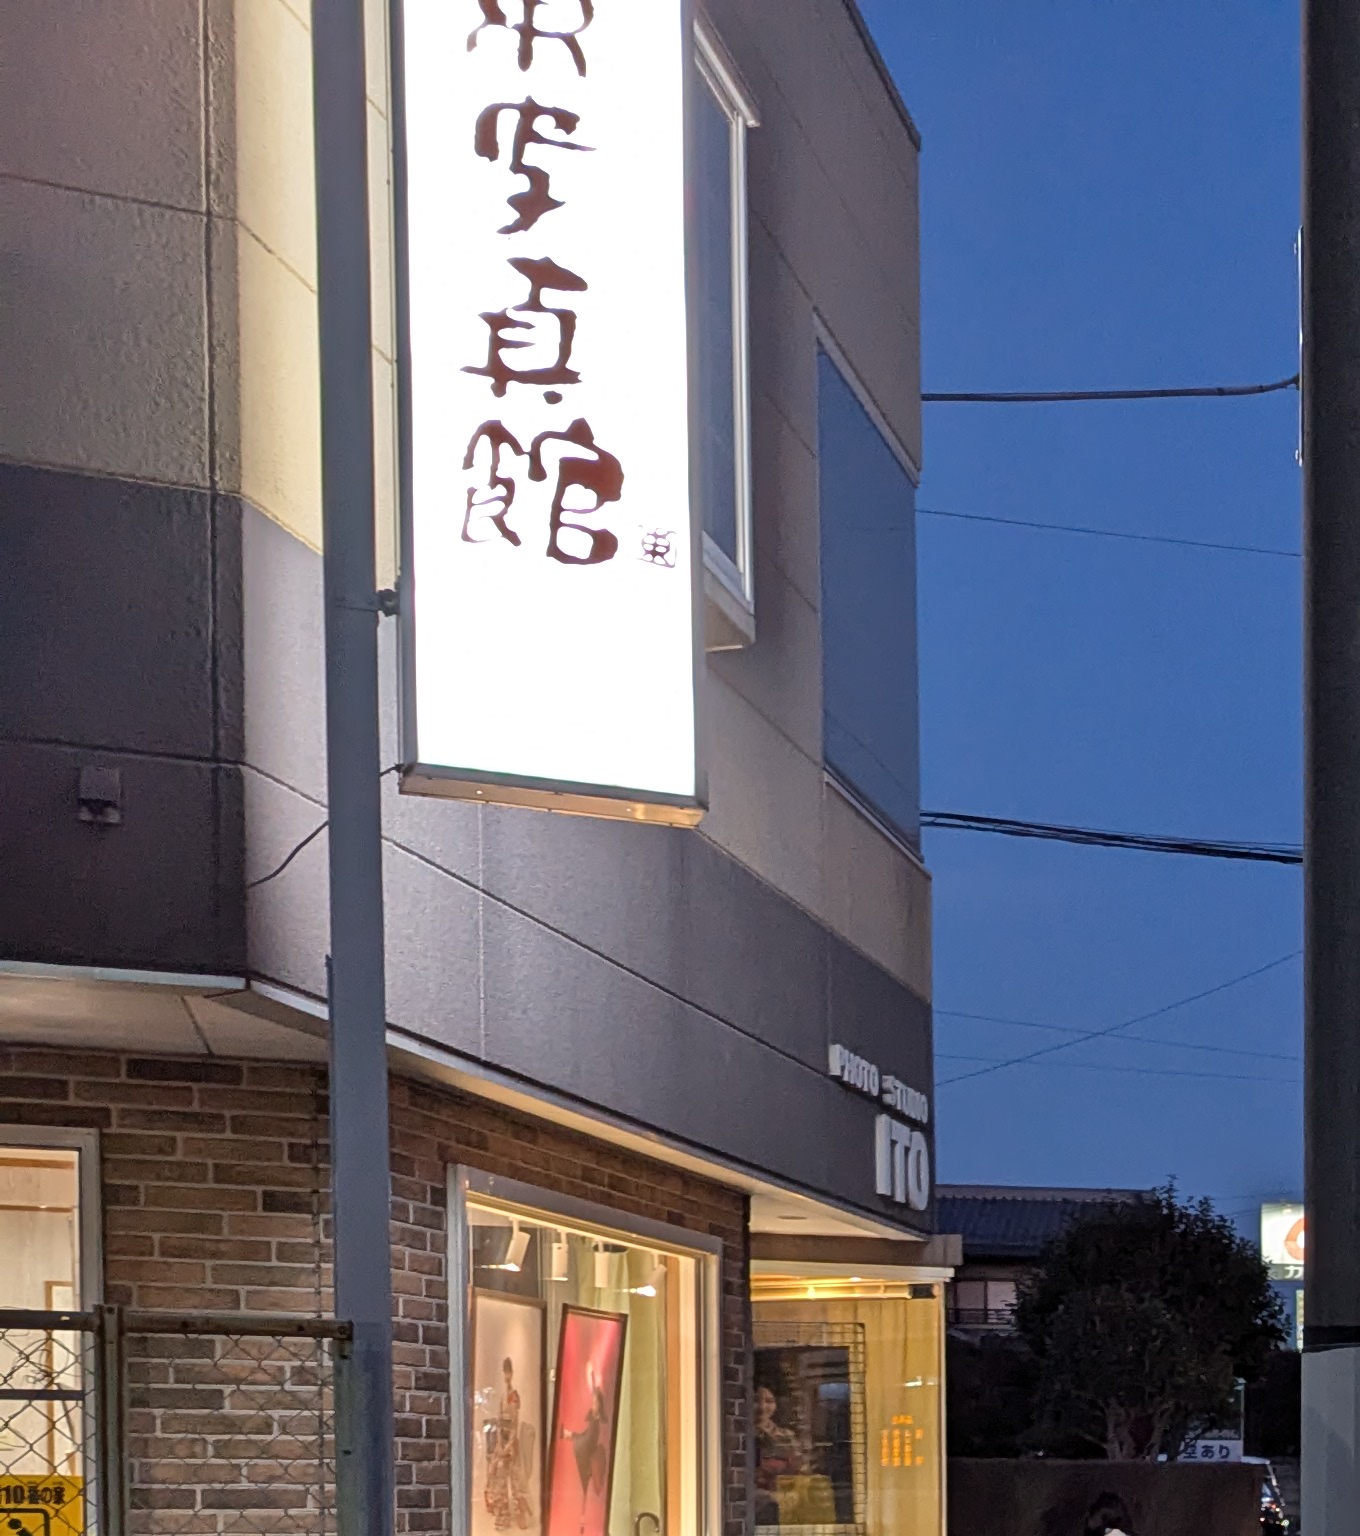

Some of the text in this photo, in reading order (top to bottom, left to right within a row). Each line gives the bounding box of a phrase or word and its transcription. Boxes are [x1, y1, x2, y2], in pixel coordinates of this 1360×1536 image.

[829, 1044, 929, 1124] PHOTO STUDIO
[875, 1114, 930, 1210] ITO
